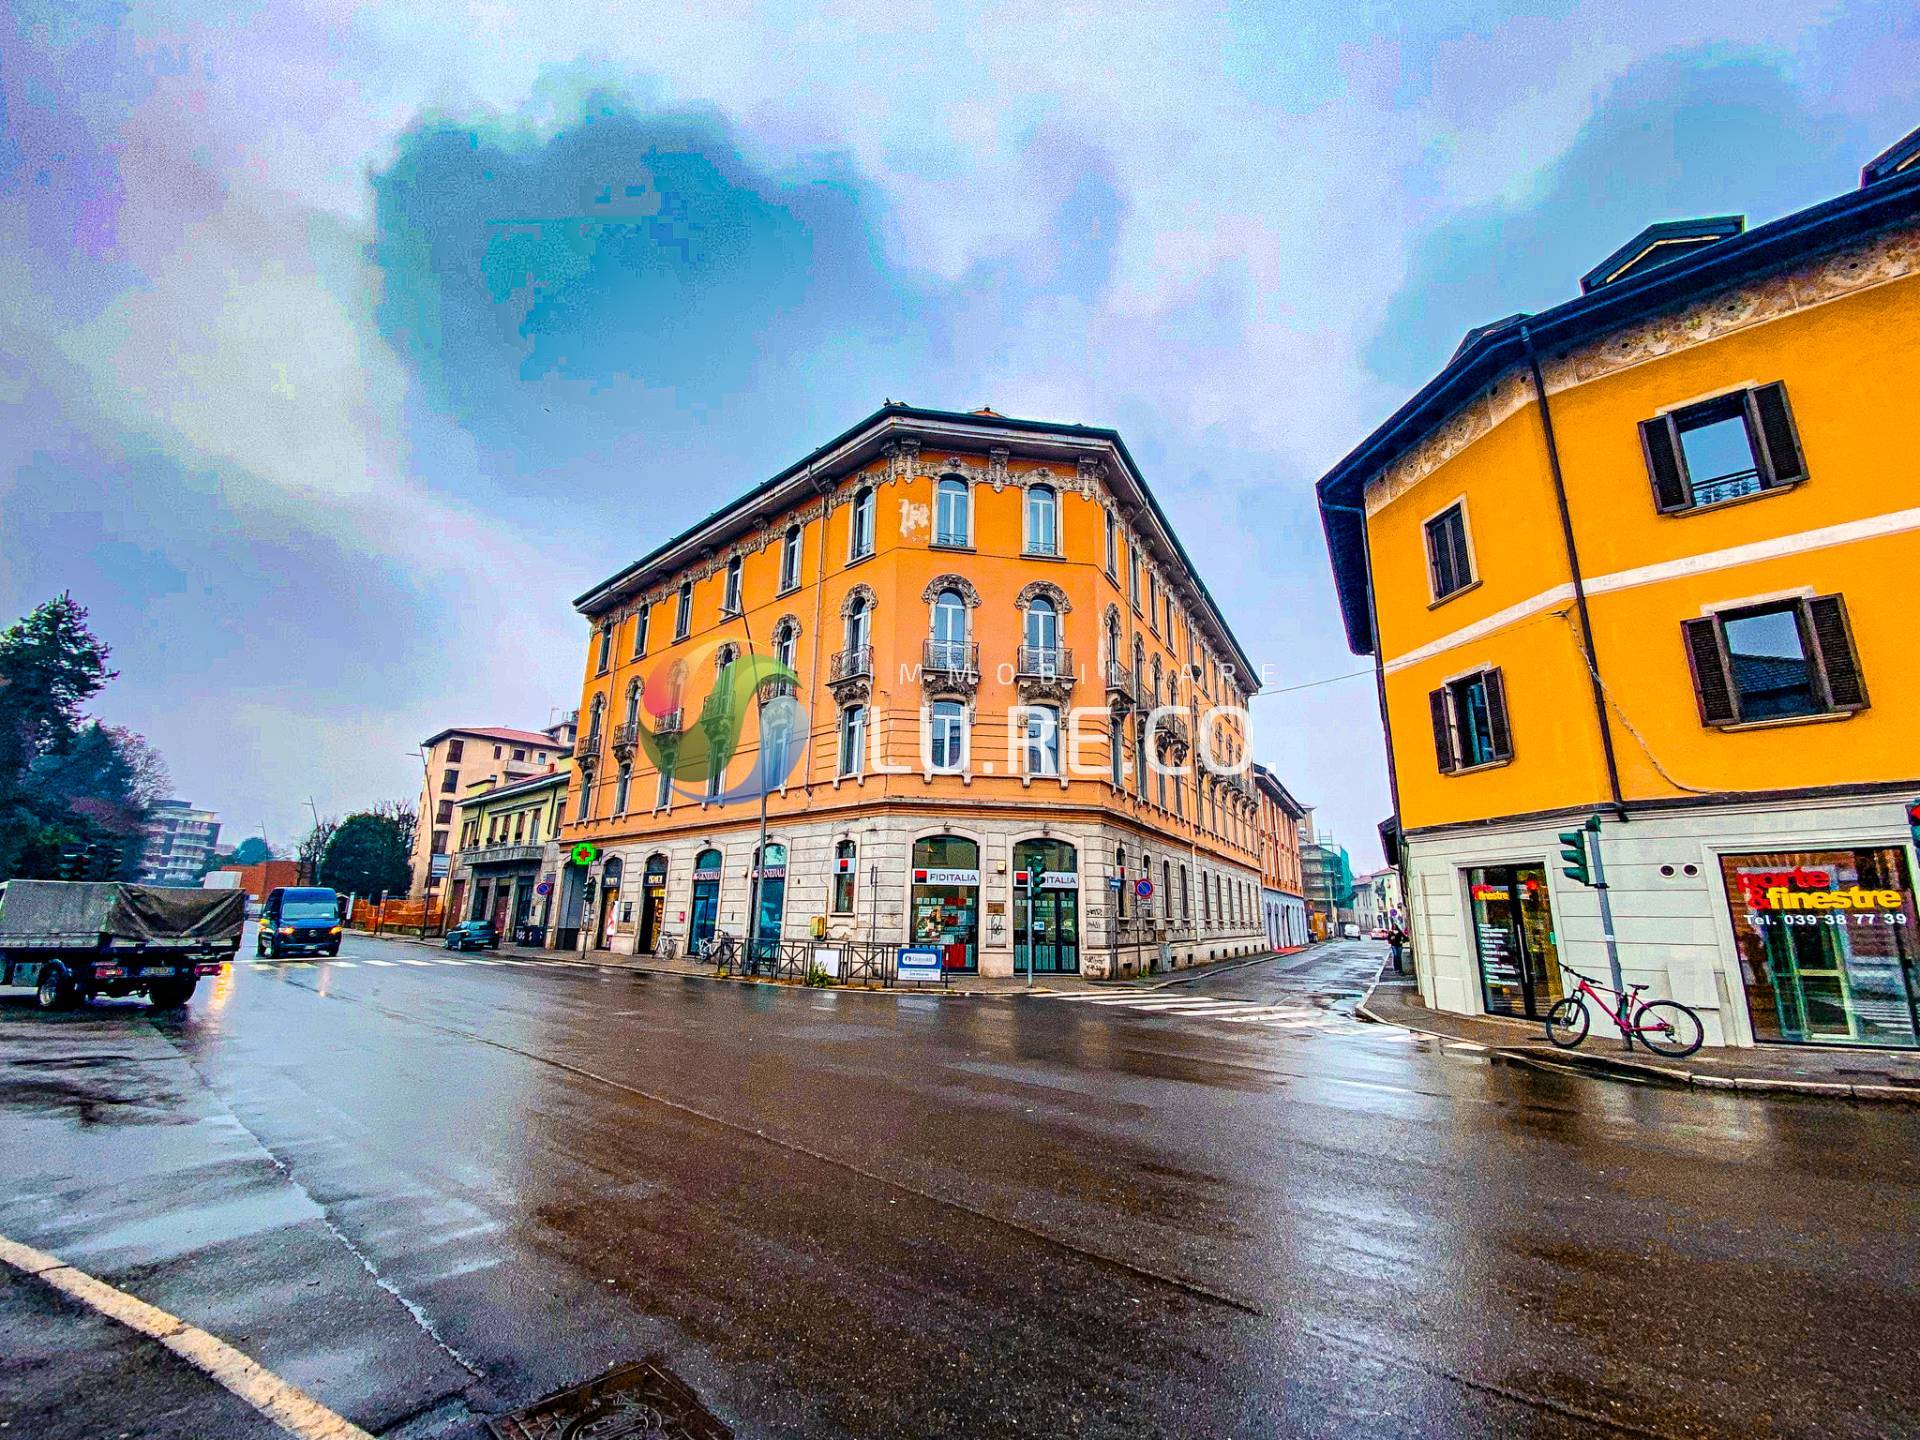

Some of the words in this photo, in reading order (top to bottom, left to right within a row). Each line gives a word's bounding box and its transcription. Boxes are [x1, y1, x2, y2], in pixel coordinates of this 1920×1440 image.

[929, 873, 977, 882] FIDITALIA
[1045, 875, 1077, 884] ITALIA
[1736, 866, 1831, 896] porte
[1766, 886, 1902, 910] finestre
[1744, 914, 1777, 926] Tel.
[1784, 913, 1817, 926] 039
[1824, 914, 1847, 926] 38
[1854, 914, 1875, 926] 77
[1884, 913, 1907, 926] 39
